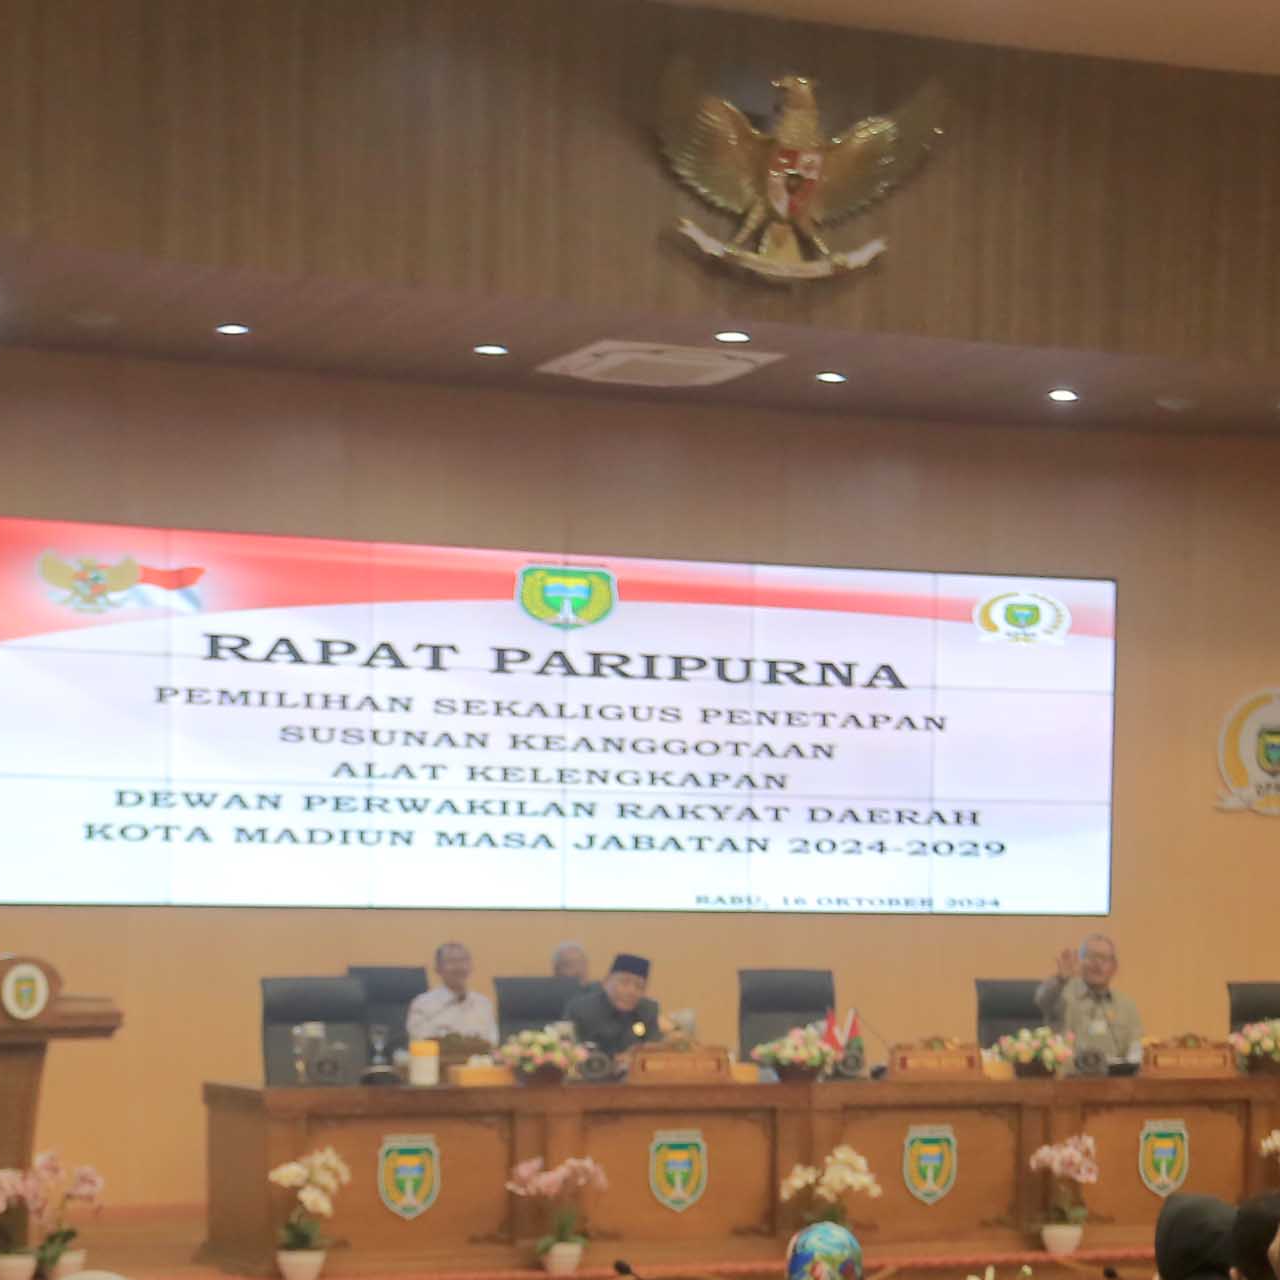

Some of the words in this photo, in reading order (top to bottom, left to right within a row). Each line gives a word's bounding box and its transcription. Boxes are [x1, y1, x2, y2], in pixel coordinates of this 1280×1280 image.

[203, 633, 461, 674] RAPAT
[490, 647, 910, 692] PARIPURNA
[155, 686, 414, 714] PEMILIHAN
[433, 699, 684, 724] SEKALIGUS
[699, 708, 948, 733] PENETAPAN
[279, 726, 490, 750] SUSUNAN
[509, 734, 837, 761] KEANGGOTAAN
[332, 761, 449, 783] ALAT
[467, 766, 789, 791] KELENGKAPAN
[114, 790, 283, 812] DEWAN
[303, 796, 598, 819] PERWAKILAN
[617, 803, 791, 824] RAKYAT
[808, 808, 982, 828] DAERAH
[83, 823, 214, 844] KOTA
[234, 827, 415, 848] MADIUN
[435, 832, 558, 850] MASA
[573, 834, 771, 855] JABATAN
[788, 838, 1008, 858] 2024-2029
